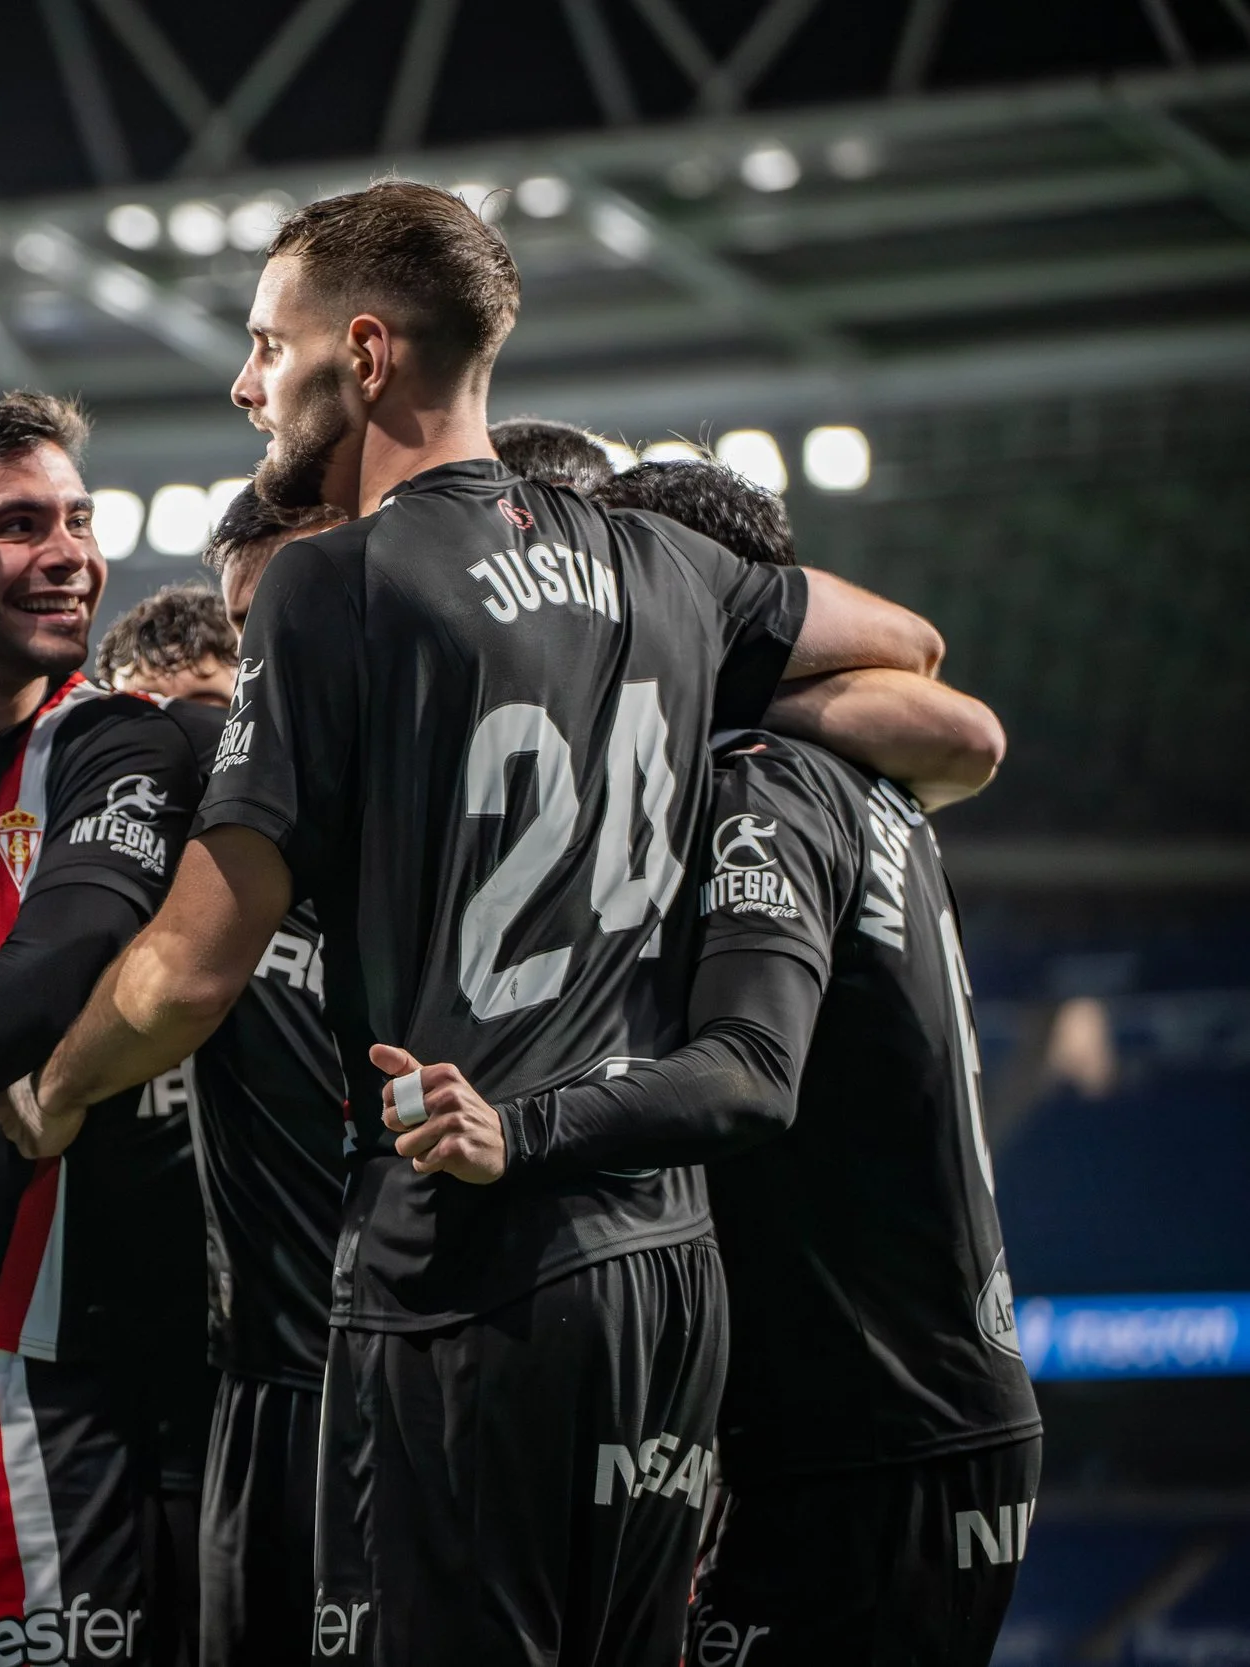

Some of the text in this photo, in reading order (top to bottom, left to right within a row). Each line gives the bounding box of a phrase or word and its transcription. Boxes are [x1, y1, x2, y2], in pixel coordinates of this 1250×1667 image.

[466, 542, 621, 625] JUSTIN
[69, 814, 166, 868] INTEGRA
[458, 677, 686, 1023] 24
[699, 870, 797, 917] INTEGRA
